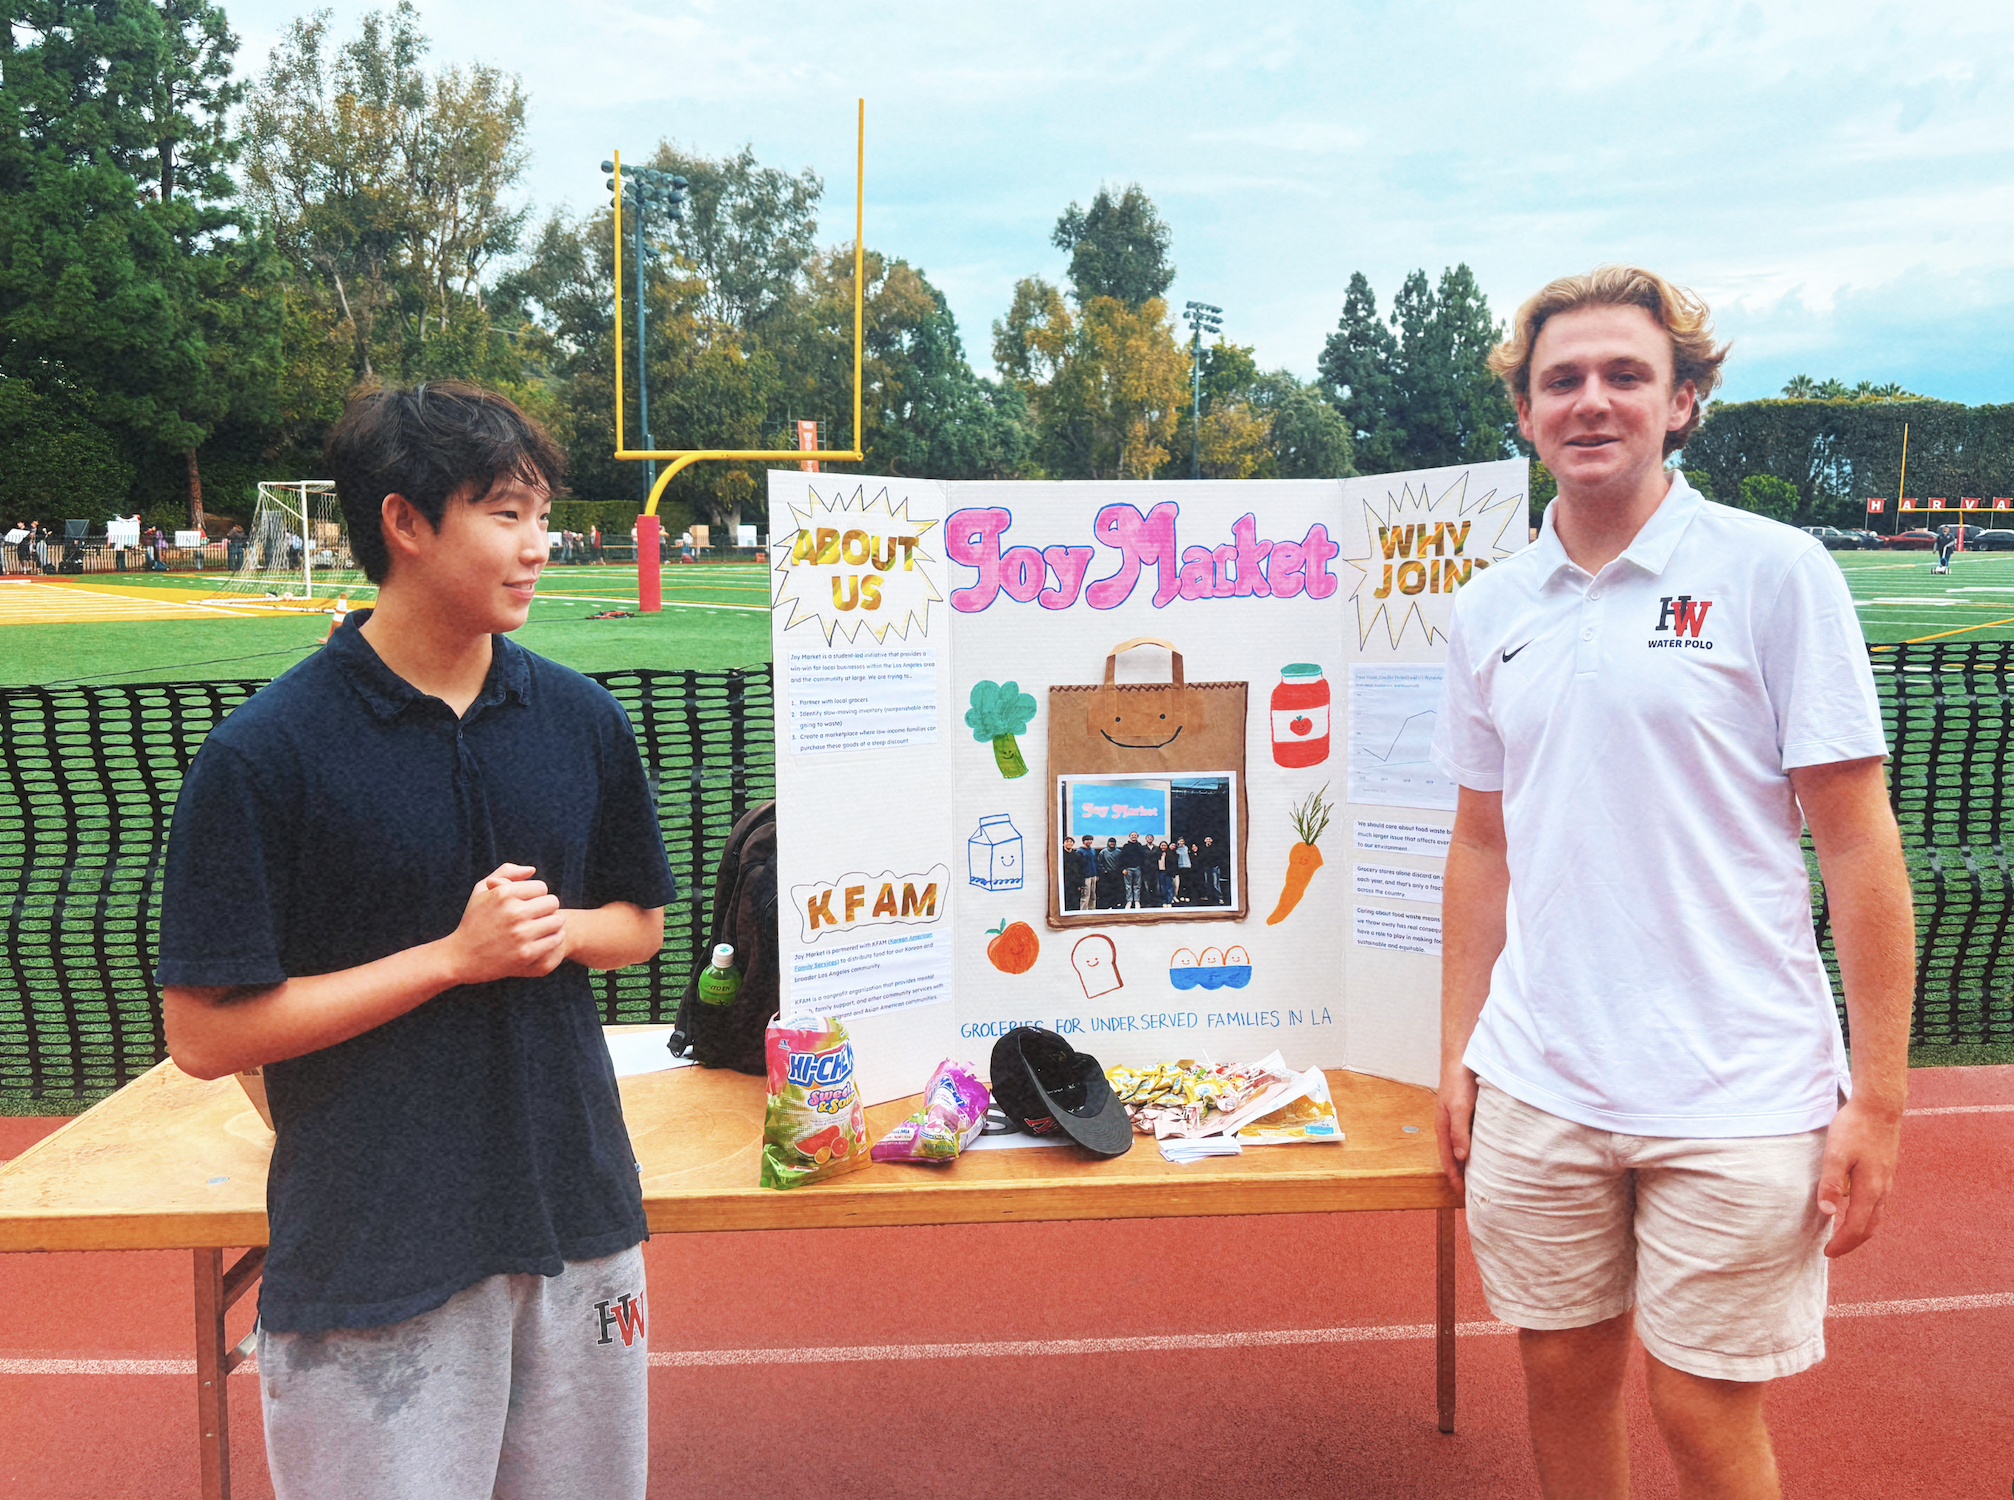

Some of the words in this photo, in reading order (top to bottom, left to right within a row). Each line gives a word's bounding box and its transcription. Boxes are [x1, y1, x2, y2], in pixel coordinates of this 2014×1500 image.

[1378, 520, 1471, 560] WHY
[791, 527, 919, 571] ABOUT
[945, 506, 1095, 613] Joy
[1085, 501, 1340, 610] Market
[832, 574, 884, 611] US
[1655, 595, 1712, 637] HW
[1648, 640, 1682, 648] WATER
[1685, 640, 1713, 650] POLO
[900, 650, 922, 658] provides
[903, 661, 922, 669] Angeles
[800, 721, 816, 729] going
[824, 730, 858, 738] marketplace
[800, 743, 825, 751] purchase
[842, 740, 859, 748] goods
[1373, 832, 1389, 840] larger
[1357, 866, 1378, 874] Grocery
[1412, 882, 1424, 890] only
[807, 882, 937, 930] KFAM
[1357, 908, 1374, 916] Caring
[1393, 932, 1405, 940] play
[805, 949, 825, 957] Market
[831, 944, 859, 955] partnered
[908, 934, 933, 942] American
[794, 962, 813, 971] Family
[873, 950, 885, 958] food
[794, 974, 817, 982] broader
[828, 968, 850, 977] Angeles
[794, 996, 811, 1004] KFAM
[894, 978, 916, 988] provides
[815, 1004, 832, 1012] family
[912, 985, 932, 993] services
[880, 1001, 904, 1010] American
[1056, 1018, 1085, 1034] FOR
[1207, 1010, 1280, 1028] FAMILIES
[1289, 1010, 1303, 1026] IN
[1311, 1007, 1332, 1025] LA
[593, 1290, 645, 1346] HW
